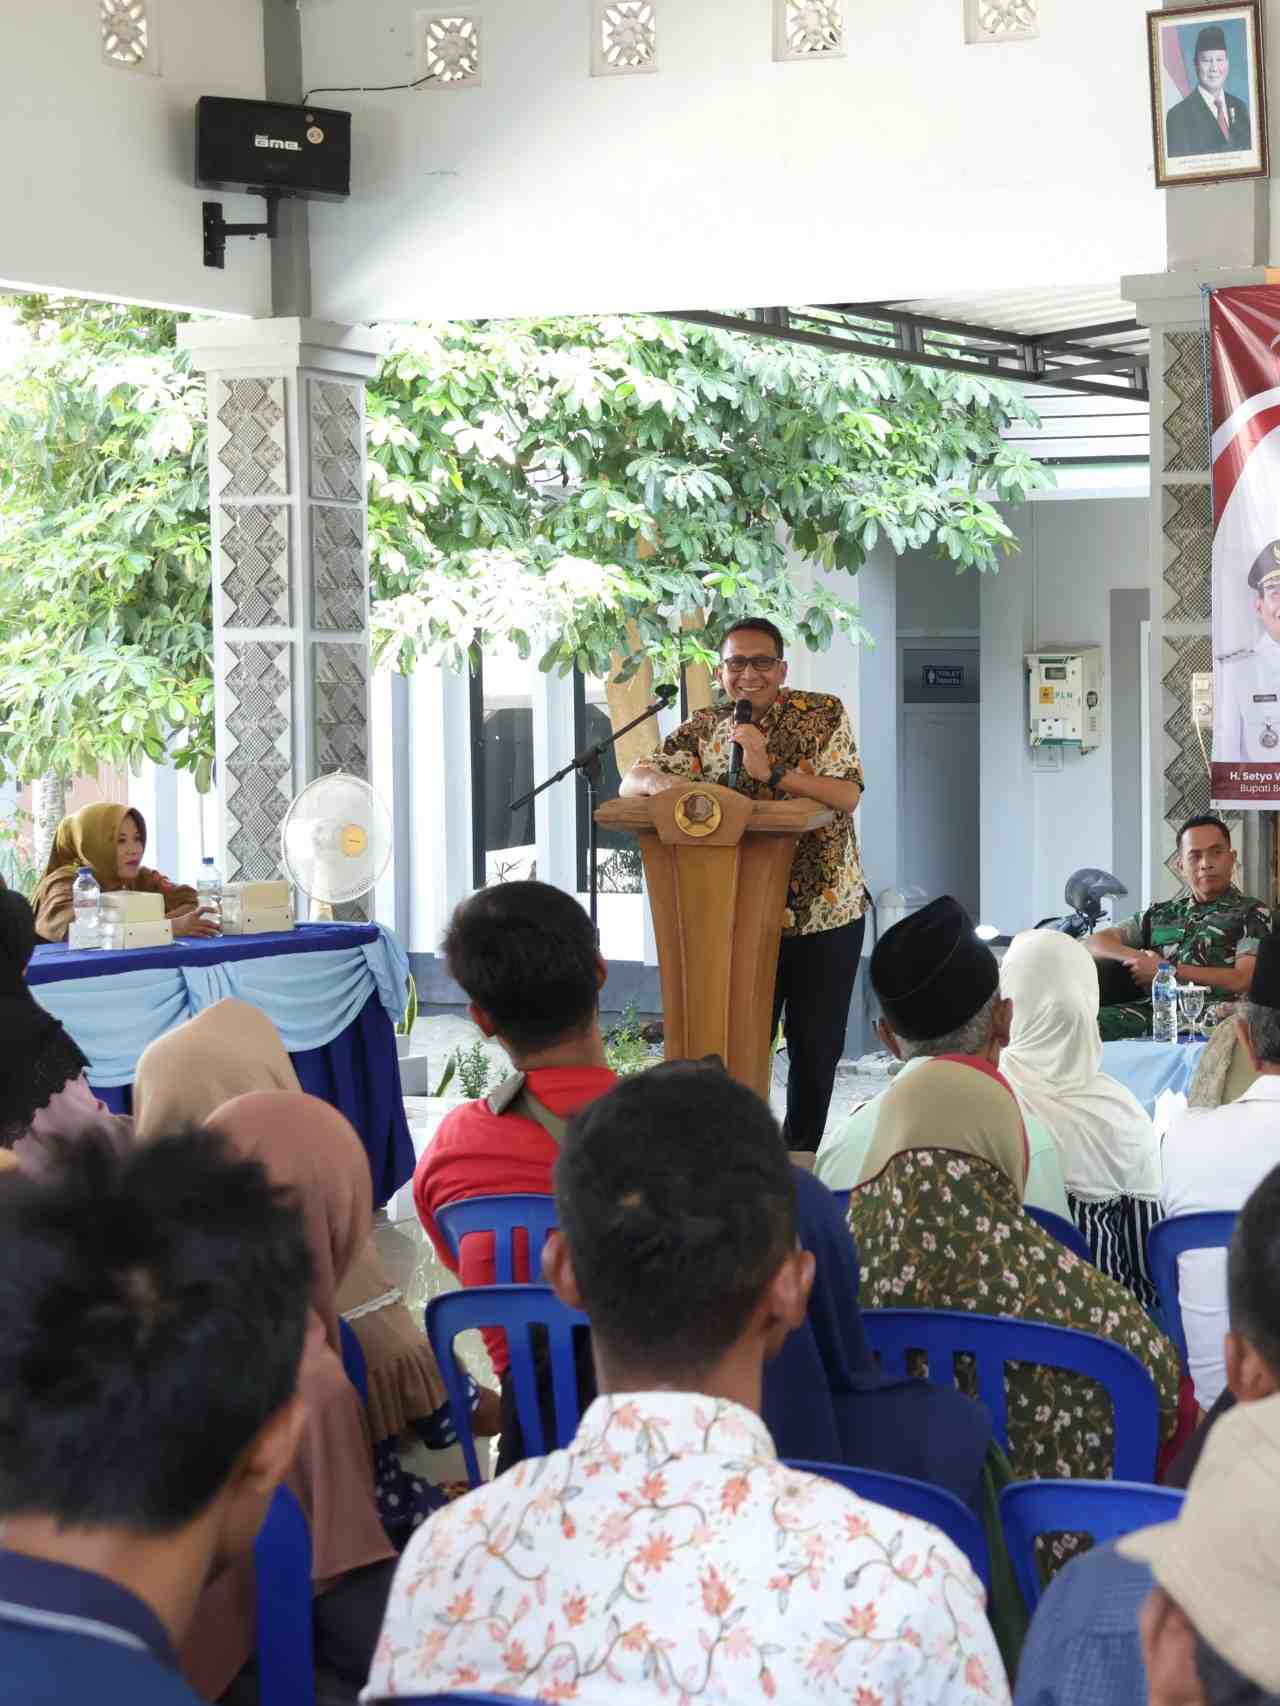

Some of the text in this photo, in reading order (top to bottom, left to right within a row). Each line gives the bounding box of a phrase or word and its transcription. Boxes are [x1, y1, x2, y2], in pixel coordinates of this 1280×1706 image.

[1229, 772, 1241, 781] H.
[1242, 772, 1273, 784] Setyo
[1240, 783, 1271, 795] Bupati
